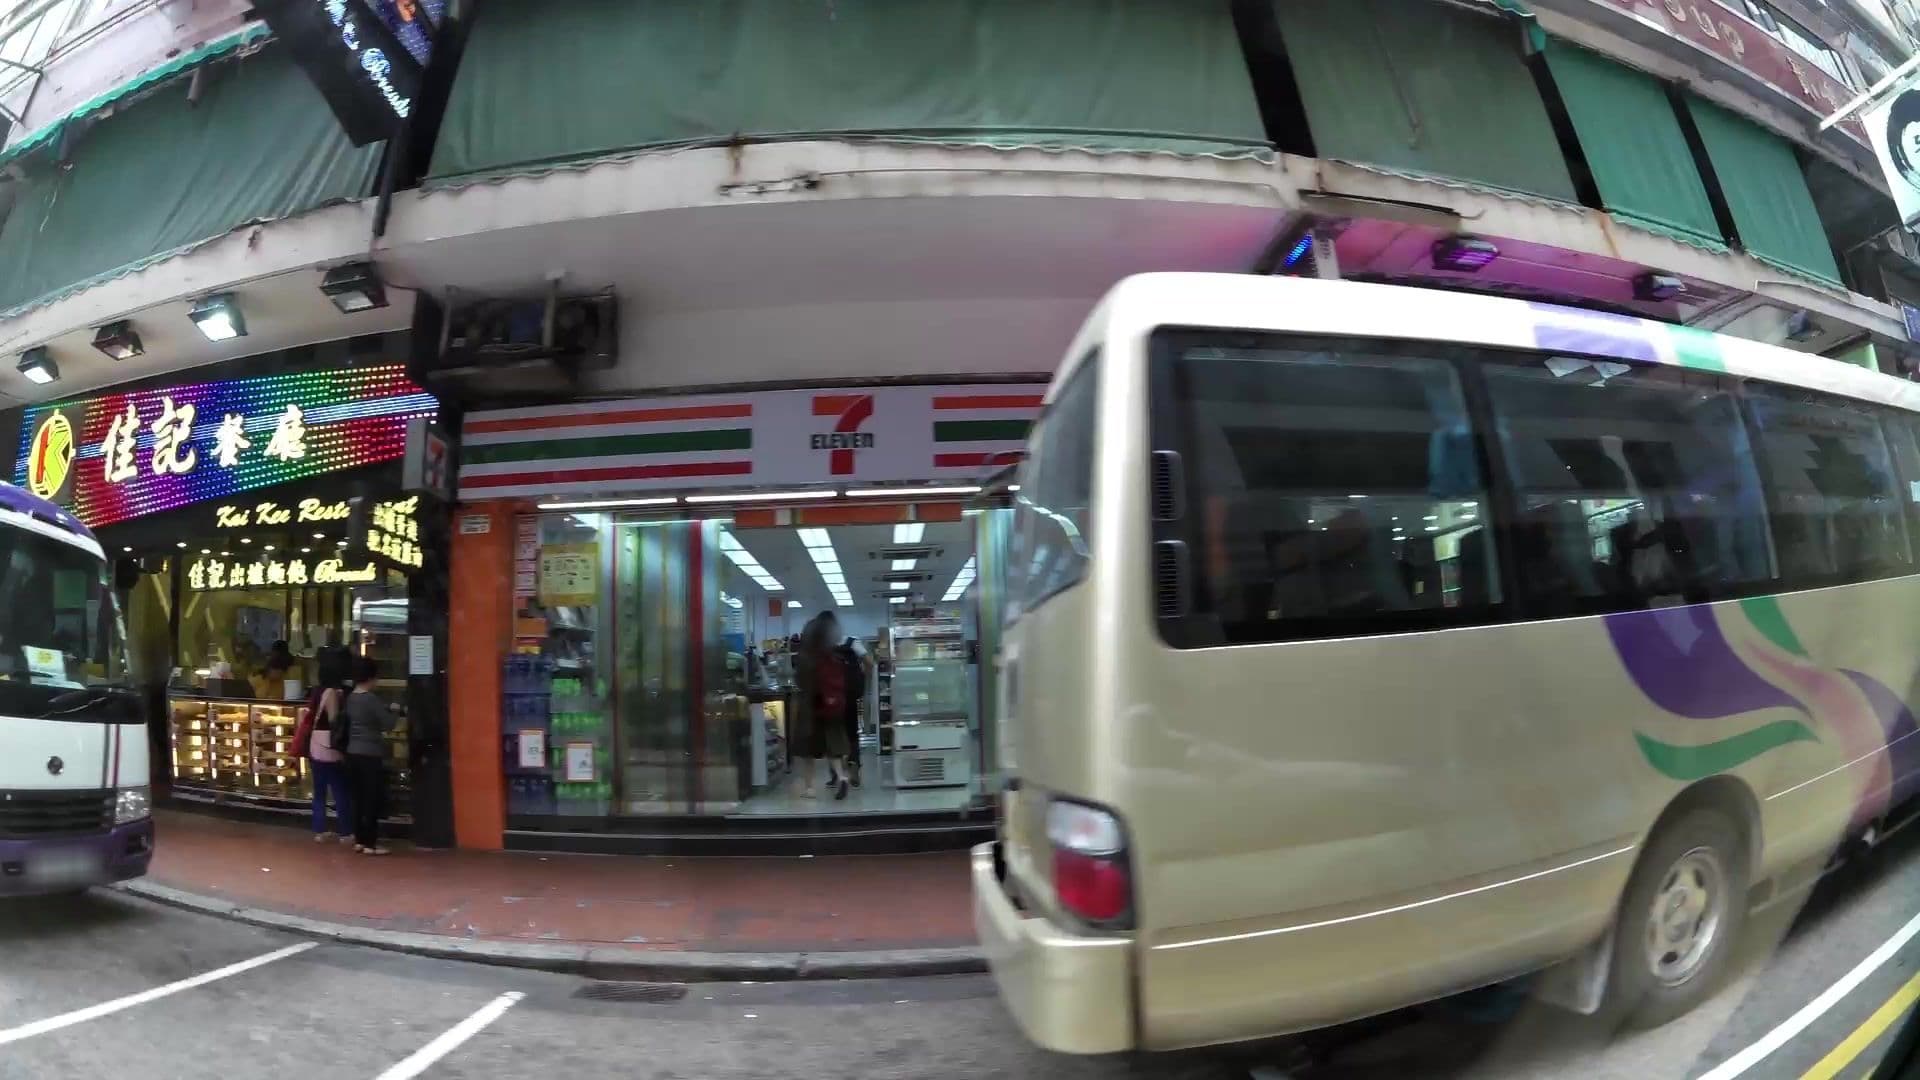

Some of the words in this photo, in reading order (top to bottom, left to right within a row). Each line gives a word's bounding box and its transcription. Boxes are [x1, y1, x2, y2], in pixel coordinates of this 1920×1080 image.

[812, 395, 873, 475] 7
[216, 505, 250, 528] Kai
[256, 502, 291, 525] Kee
